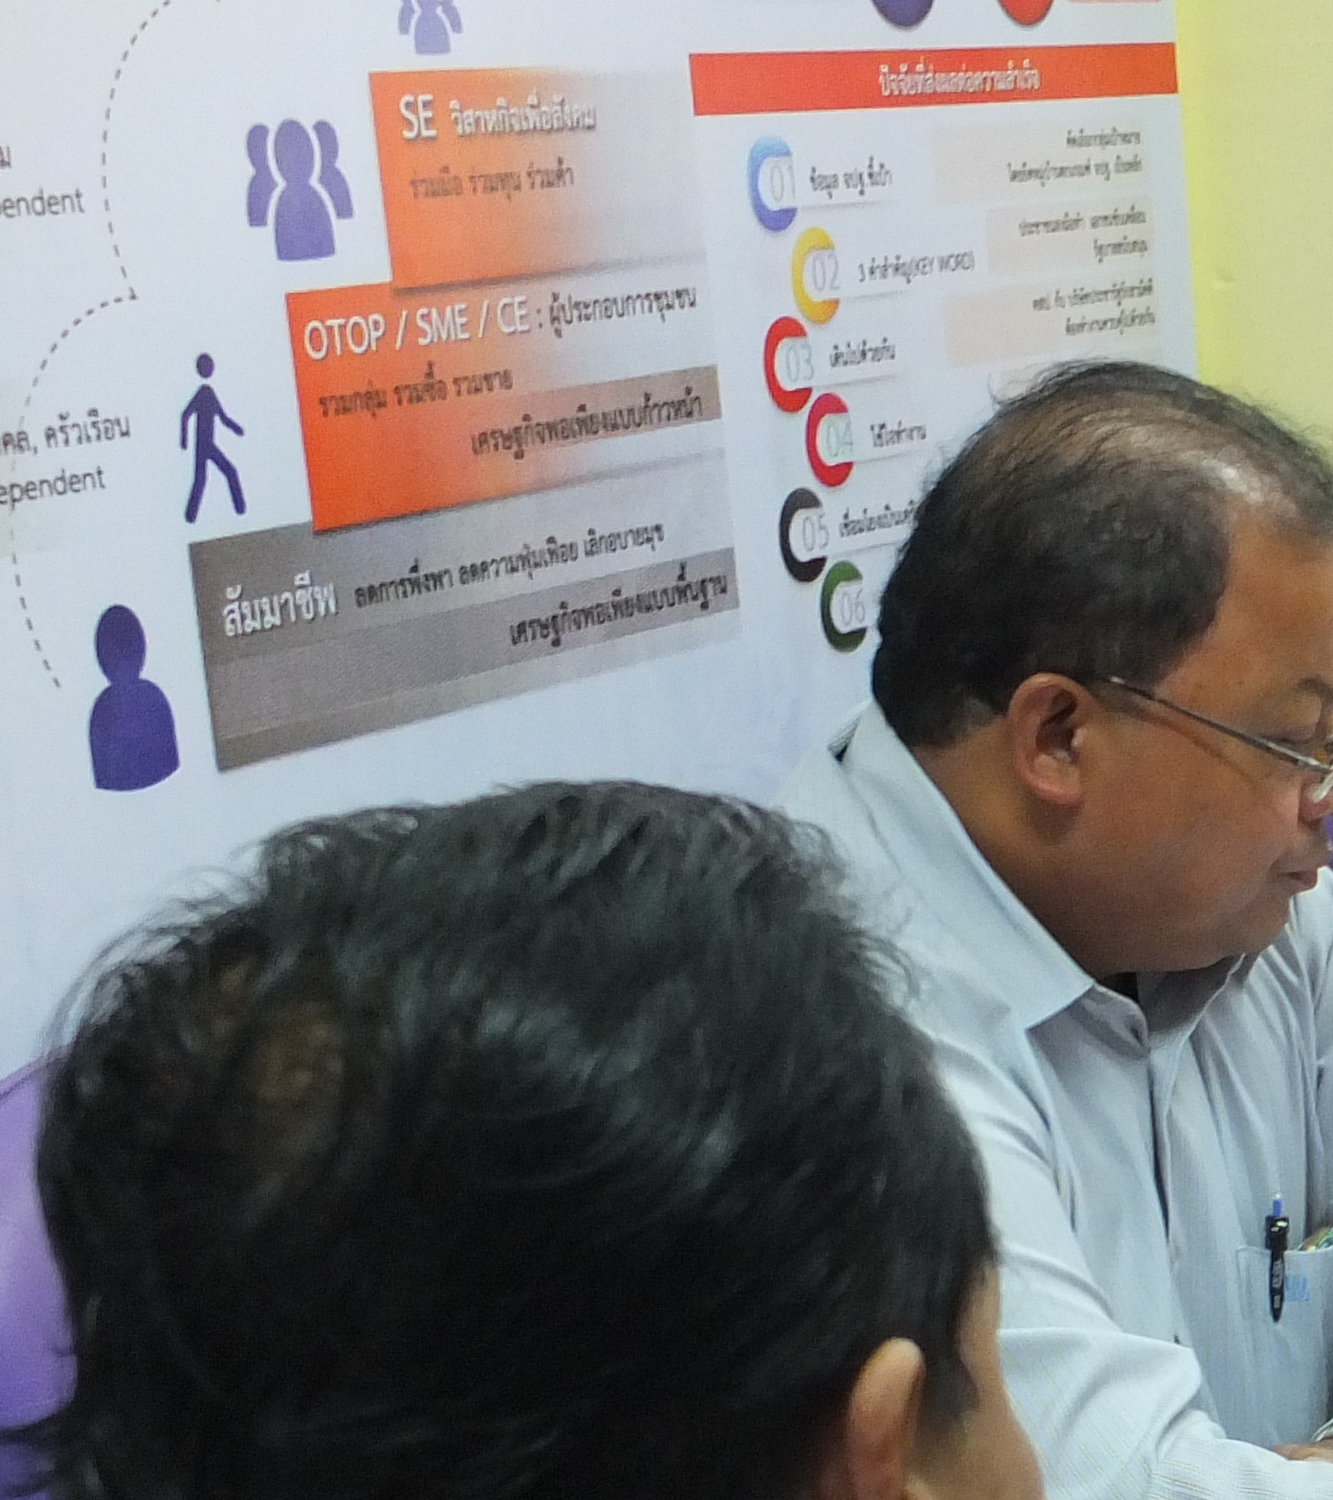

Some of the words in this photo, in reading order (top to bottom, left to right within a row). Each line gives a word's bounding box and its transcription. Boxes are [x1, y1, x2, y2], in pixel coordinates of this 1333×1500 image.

[400, 94, 437, 140] SE
[0, 187, 86, 219] endent
[812, 253, 841, 292] 02
[304, 312, 387, 360] OTOP
[395, 310, 408, 350] /
[417, 302, 471, 346] SME
[478, 299, 490, 339] /
[498, 295, 531, 334] CE
[549, 287, 697, 339] ผู้ประกอบการชุมชน
[45, 408, 131, 448] ครัวเรือน
[221, 569, 337, 637] สัมมาชีพ
[583, 522, 664, 557] เลิกอบายมุข
